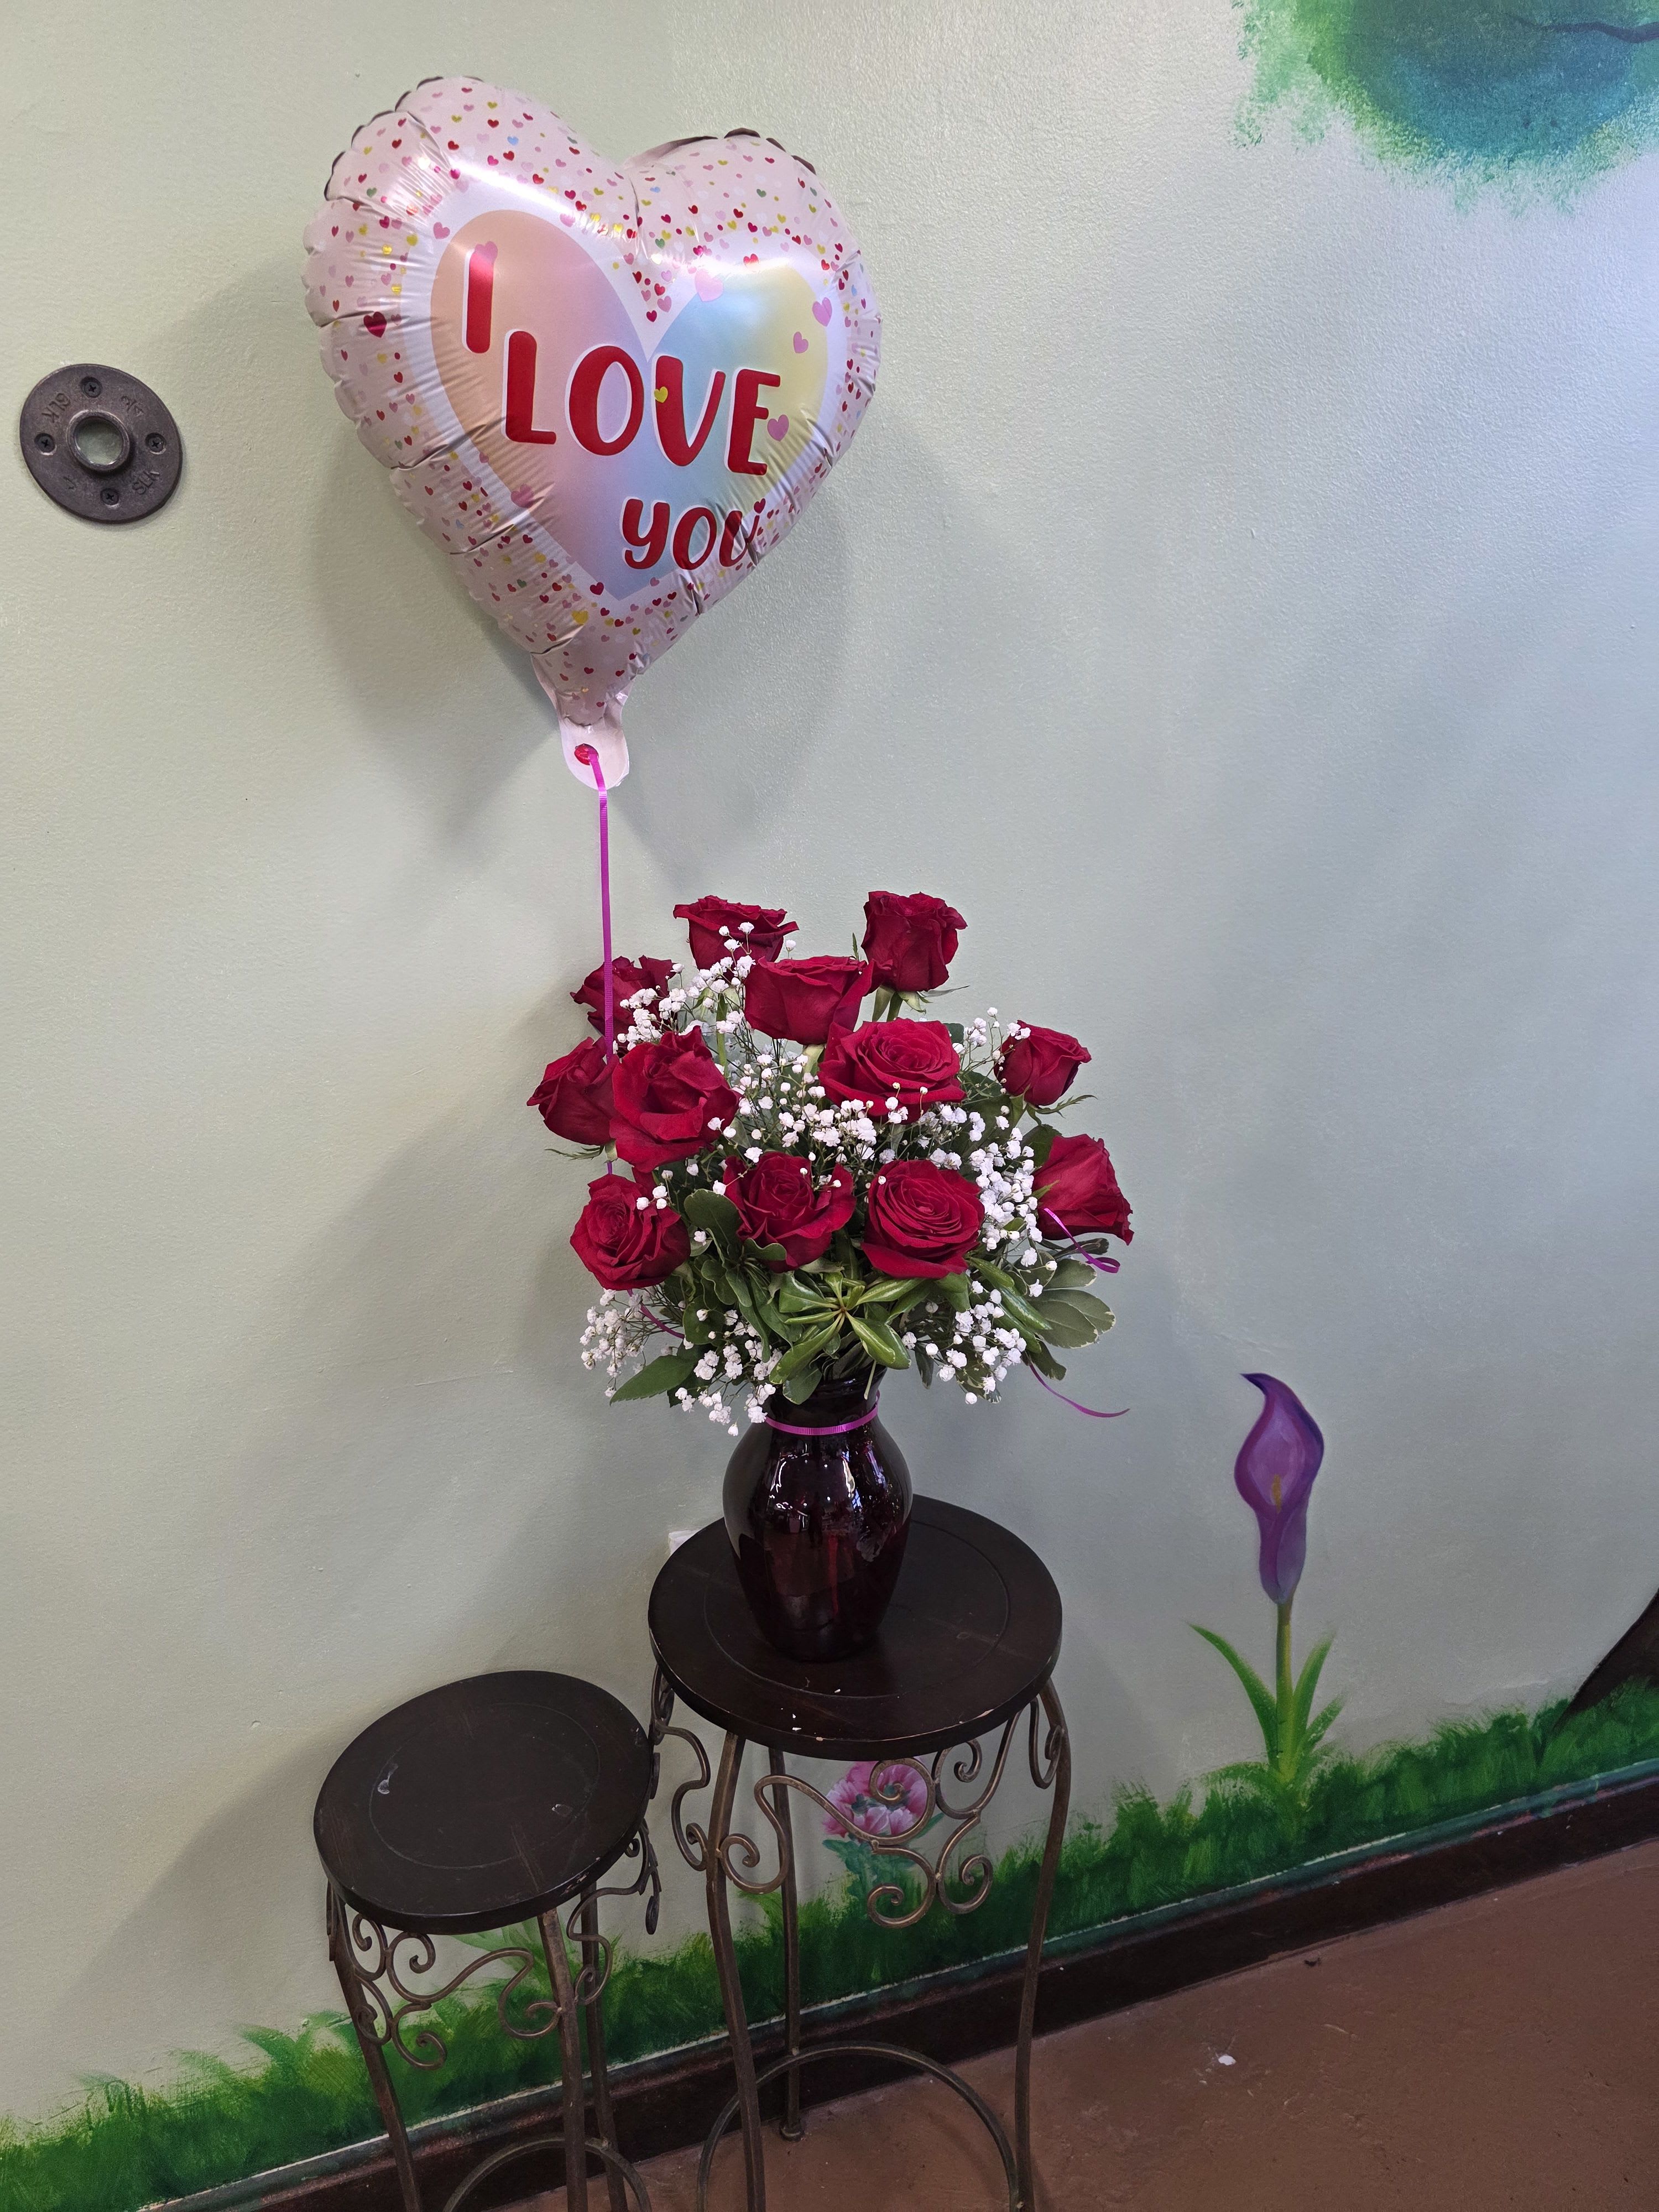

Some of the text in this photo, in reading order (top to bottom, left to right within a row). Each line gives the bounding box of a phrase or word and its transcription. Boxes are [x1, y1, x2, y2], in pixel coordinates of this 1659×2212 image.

[466, 249, 494, 354] I
[504, 331, 781, 476] LOVE
[621, 497, 760, 571] YOU
